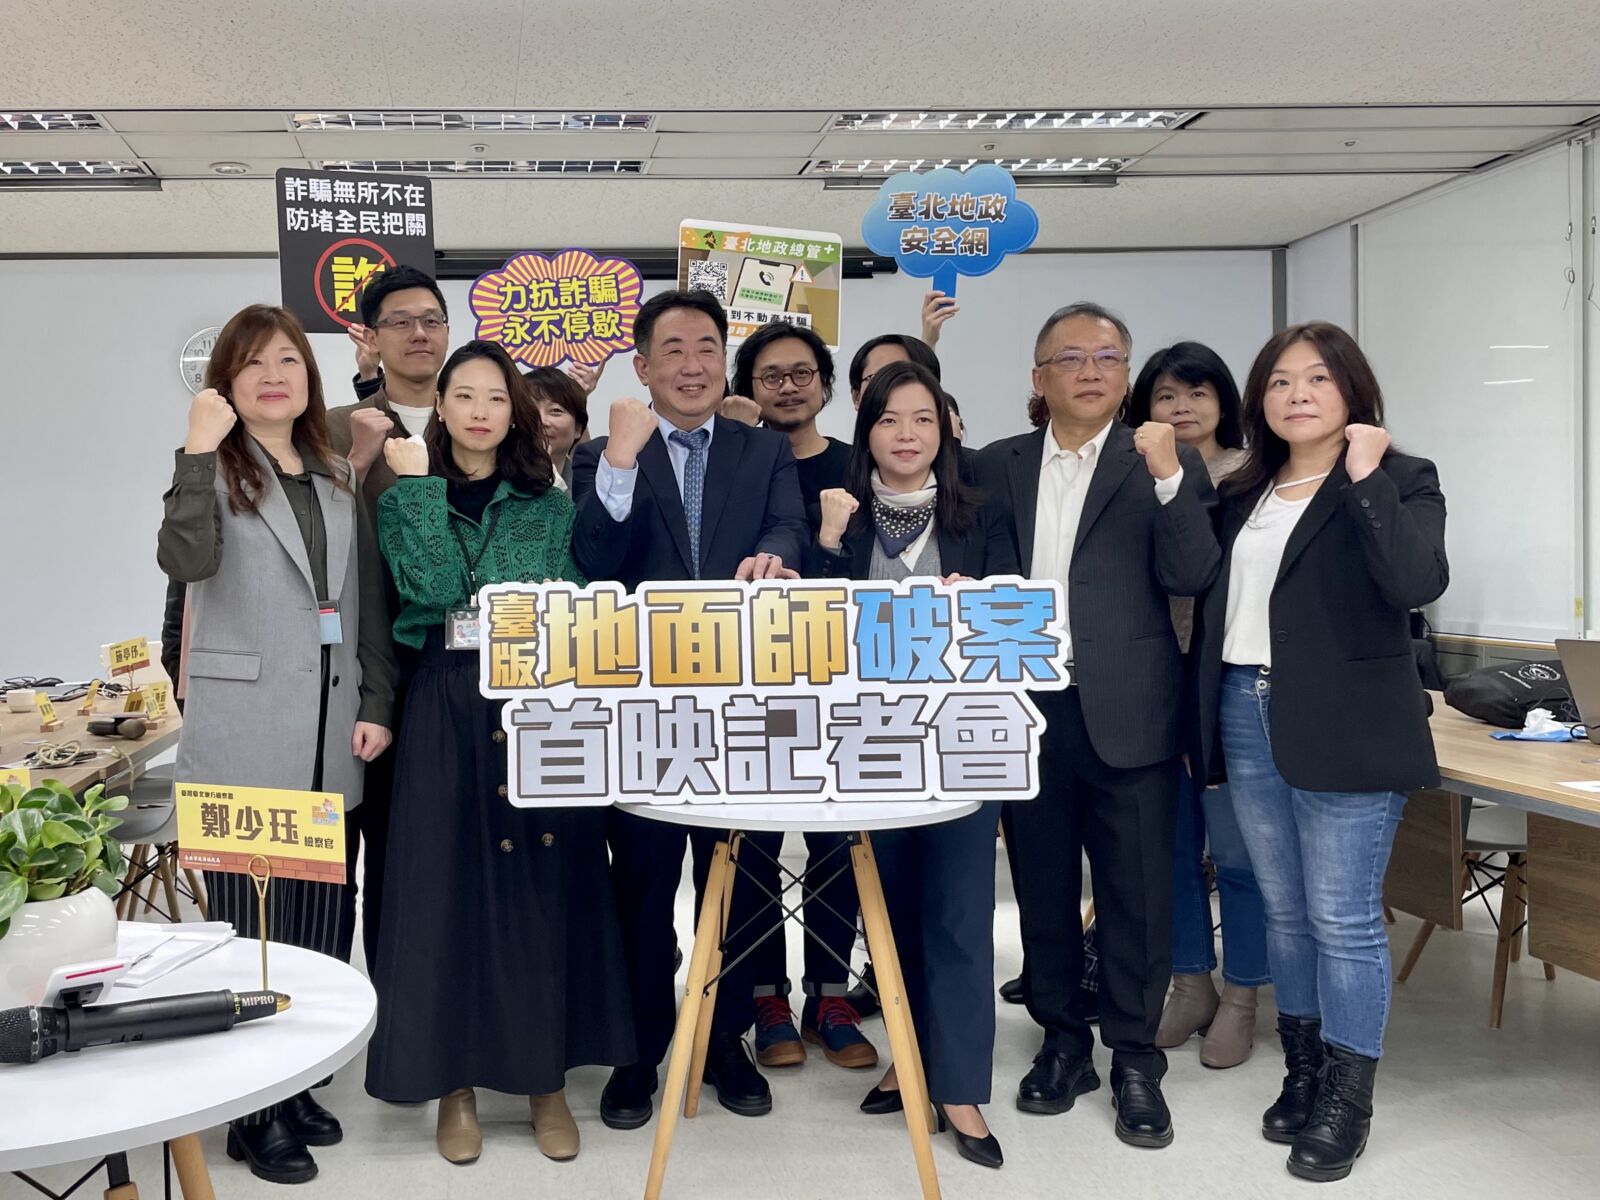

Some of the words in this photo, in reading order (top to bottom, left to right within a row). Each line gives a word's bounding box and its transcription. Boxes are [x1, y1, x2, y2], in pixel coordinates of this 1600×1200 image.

[284, 177, 426, 208] 詐騙無所不在
[887, 191, 1009, 223] 臺北地政
[286, 207, 427, 236] 防堵全民把關
[899, 226, 990, 256] 安全網
[499, 273, 618, 311] 力抗詐騙
[502, 310, 623, 346] 永不停歇
[487, 591, 540, 690] 臺版
[510, 691, 1039, 799] 首映記者會
[241, 995, 275, 1007] MIPRO
